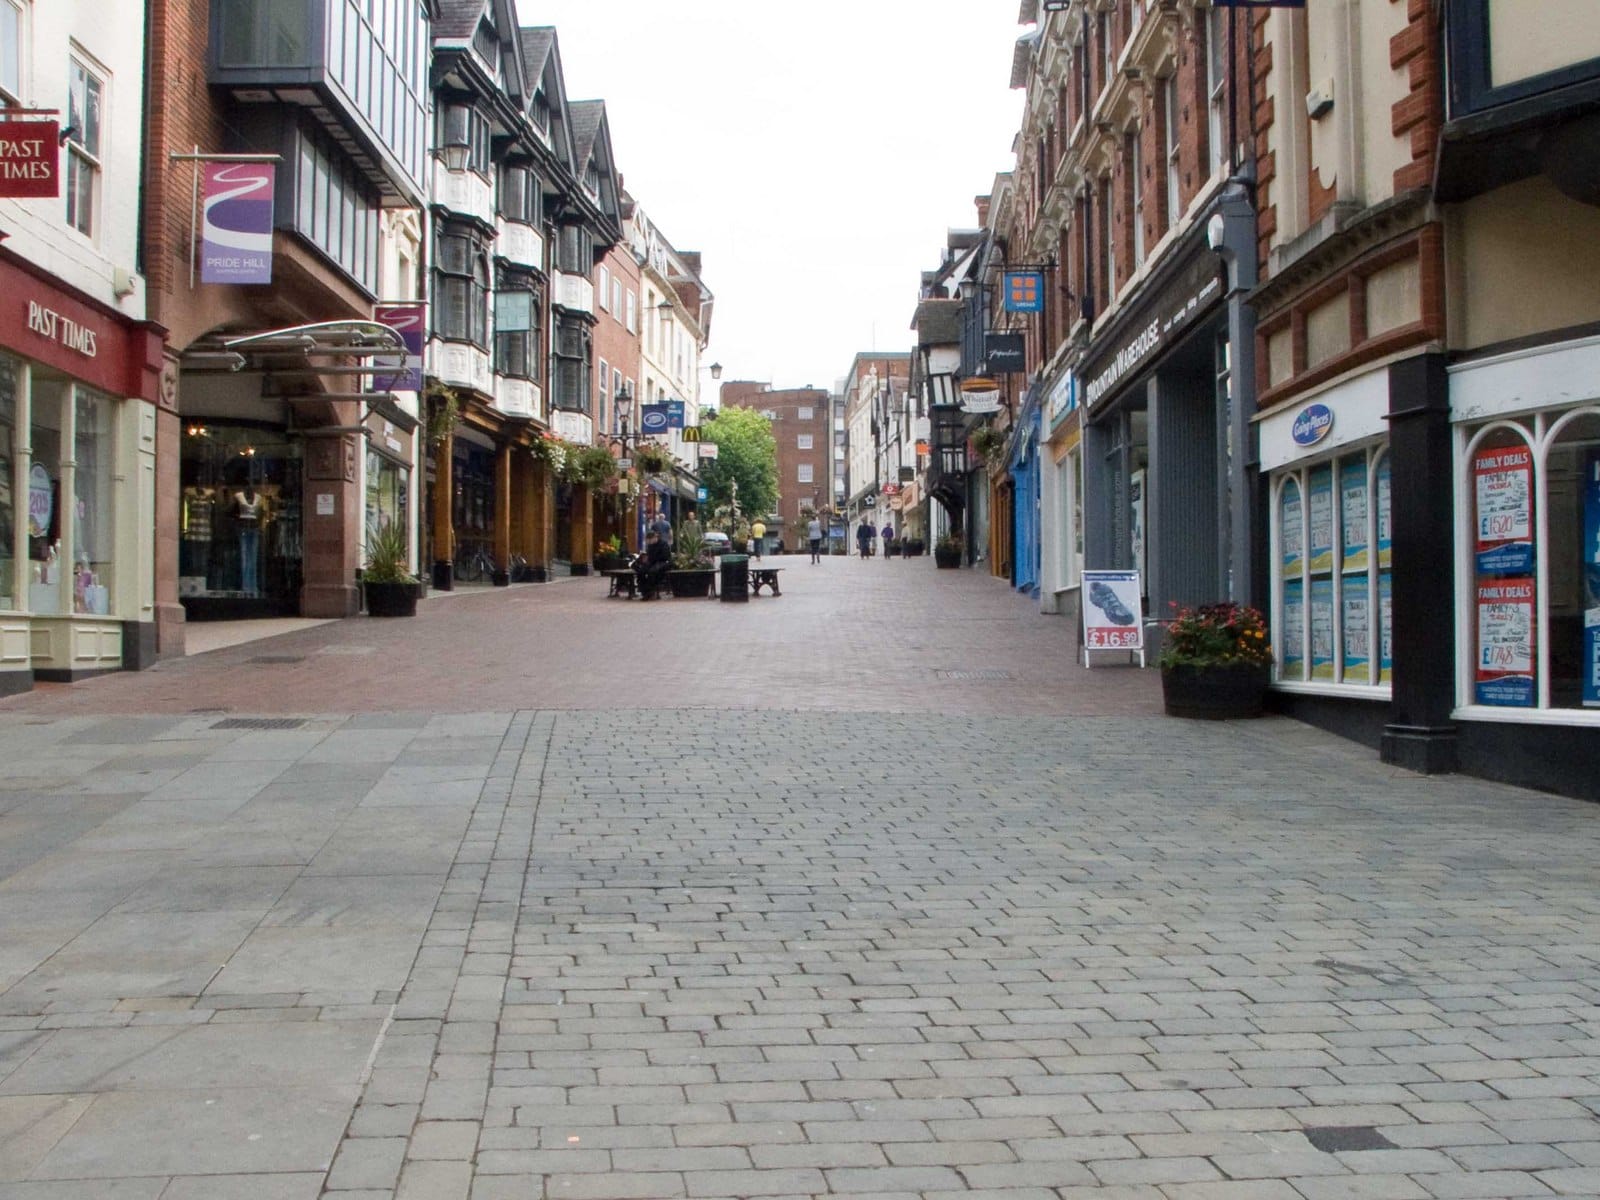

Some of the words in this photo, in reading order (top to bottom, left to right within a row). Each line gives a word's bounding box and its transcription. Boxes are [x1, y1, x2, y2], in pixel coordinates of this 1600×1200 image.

[0, 139, 44, 158] PAST
[207, 257, 240, 268] PRIDE
[243, 257, 266, 268] HILL
[28, 300, 59, 339] PAST
[60, 316, 97, 357] TIMES
[1086, 361, 1118, 408] MOUNTAIN
[1117, 317, 1159, 378] WAREHOUSE
[1294, 420, 1310, 436] Going
[1310, 413, 1329, 431] Places
[1476, 455, 1503, 470] FAMILY
[1504, 453, 1528, 466] DEALS
[1479, 587, 1504, 599] FAMILY
[1506, 586, 1531, 598] DEALS
[1089, 631, 1137, 647] £16.99
